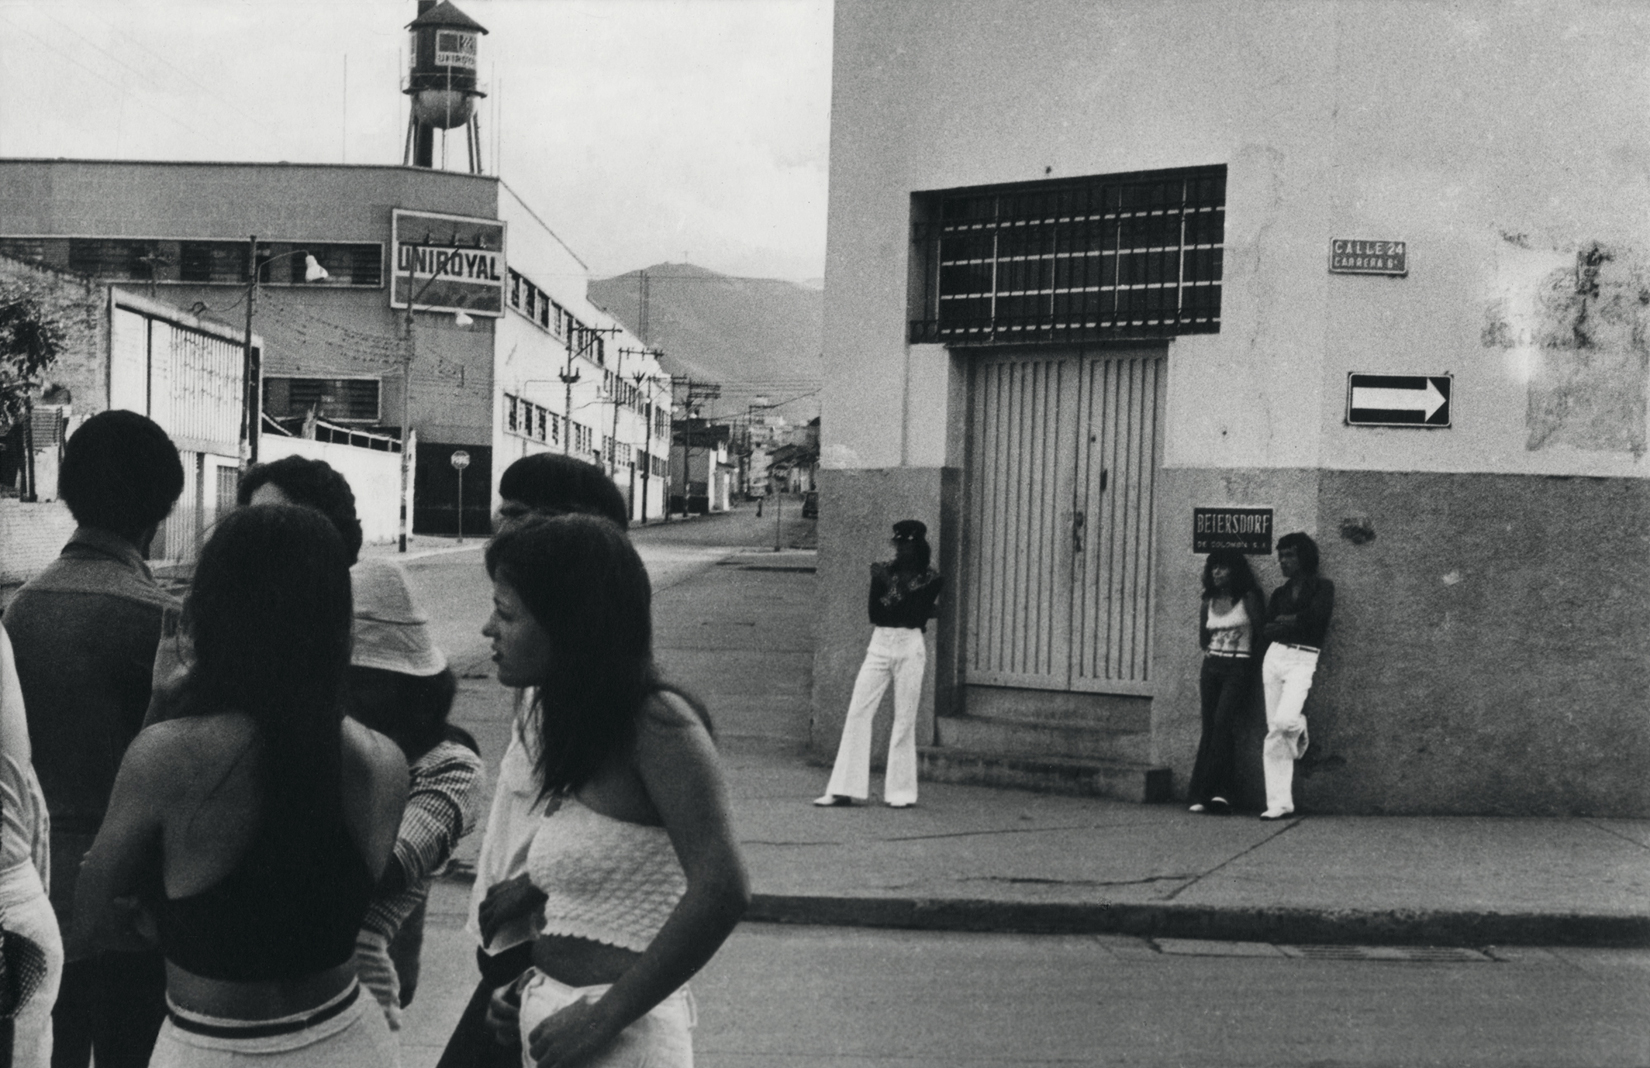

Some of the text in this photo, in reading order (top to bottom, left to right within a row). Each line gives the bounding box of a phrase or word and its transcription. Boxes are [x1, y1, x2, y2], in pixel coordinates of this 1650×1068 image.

[1335, 241, 1403, 255] CALLE 24
[398, 245, 500, 281] UNIROYAL
[1334, 257, 1383, 268] CARRERA
[1197, 513, 1270, 534] BEIERSDORF
